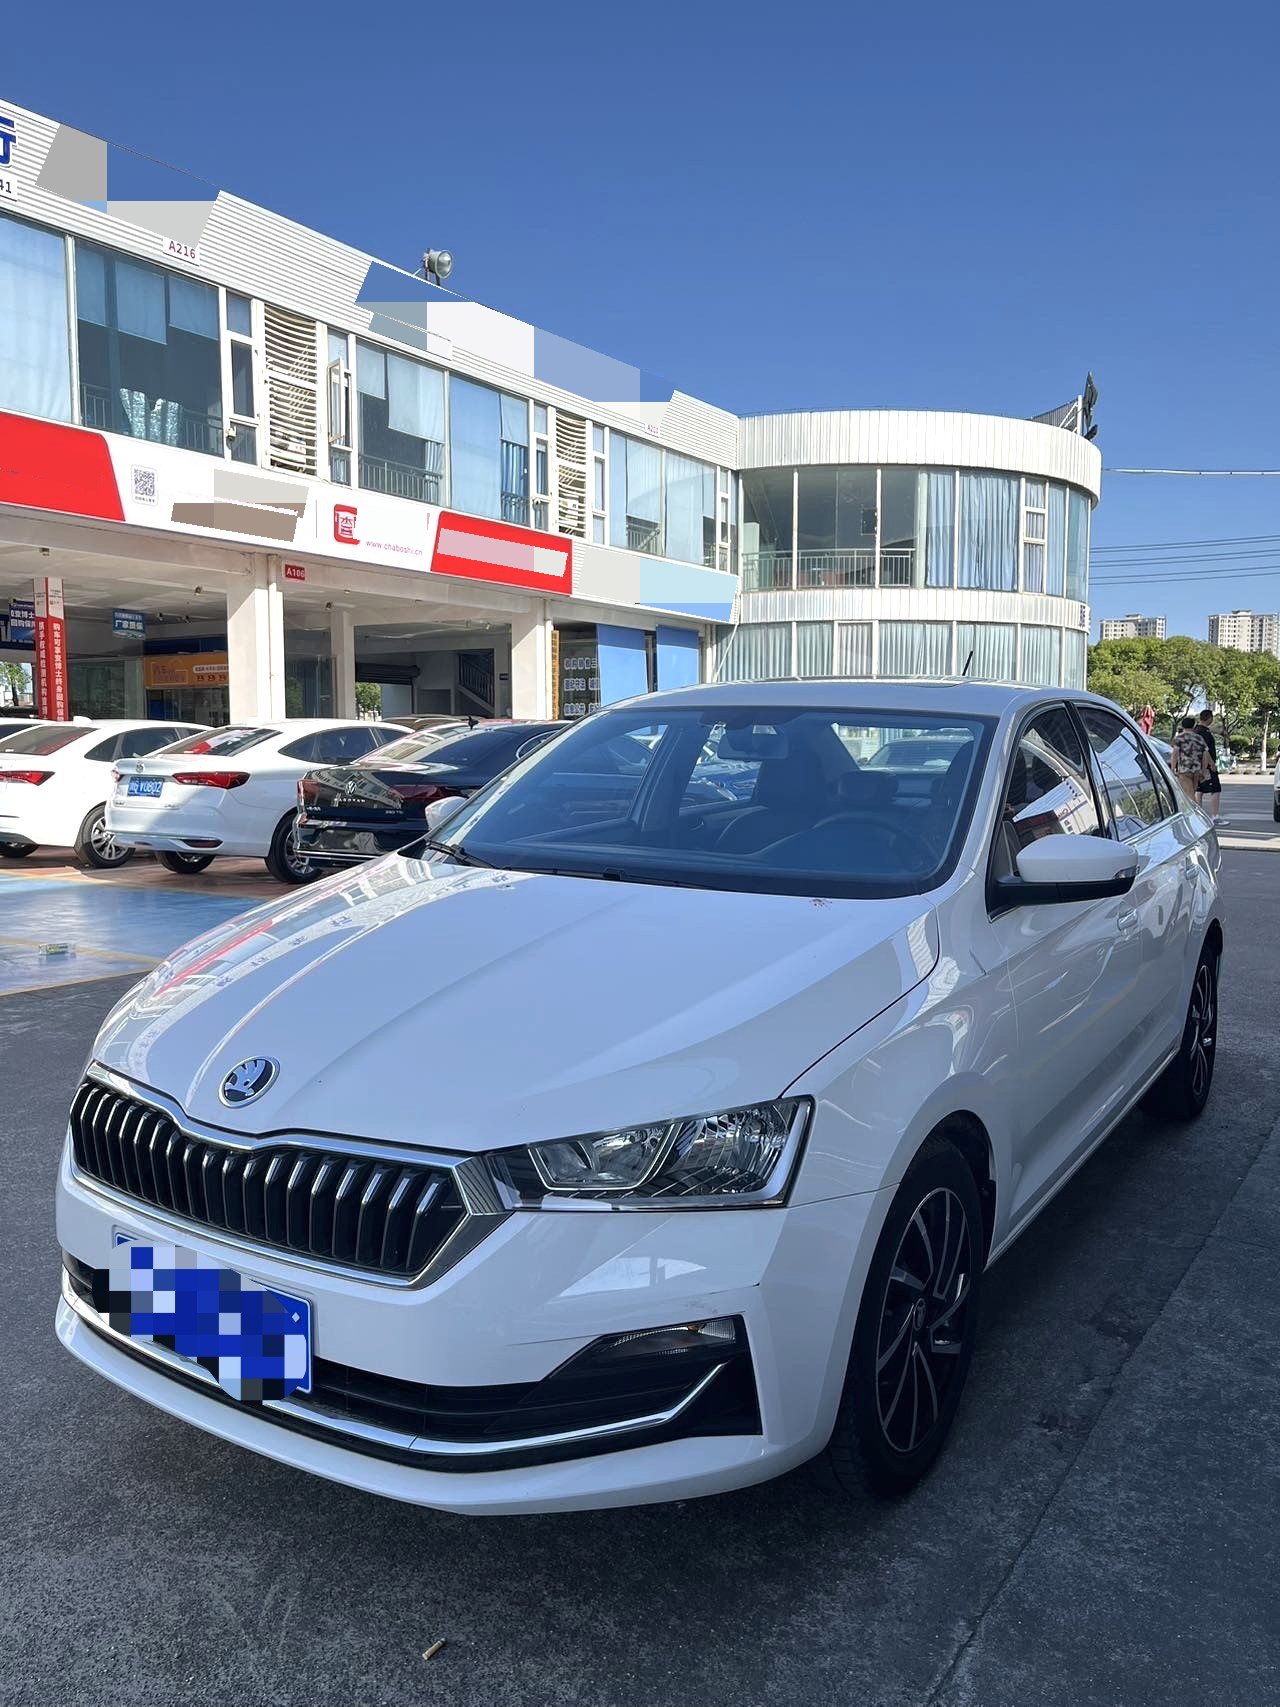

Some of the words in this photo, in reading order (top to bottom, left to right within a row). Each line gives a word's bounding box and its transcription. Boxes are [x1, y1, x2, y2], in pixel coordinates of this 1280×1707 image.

[168, 240, 196, 259] A216
[365, 541, 423, 556] www.chaboshi.cn
[286, 567, 305, 578] A106
